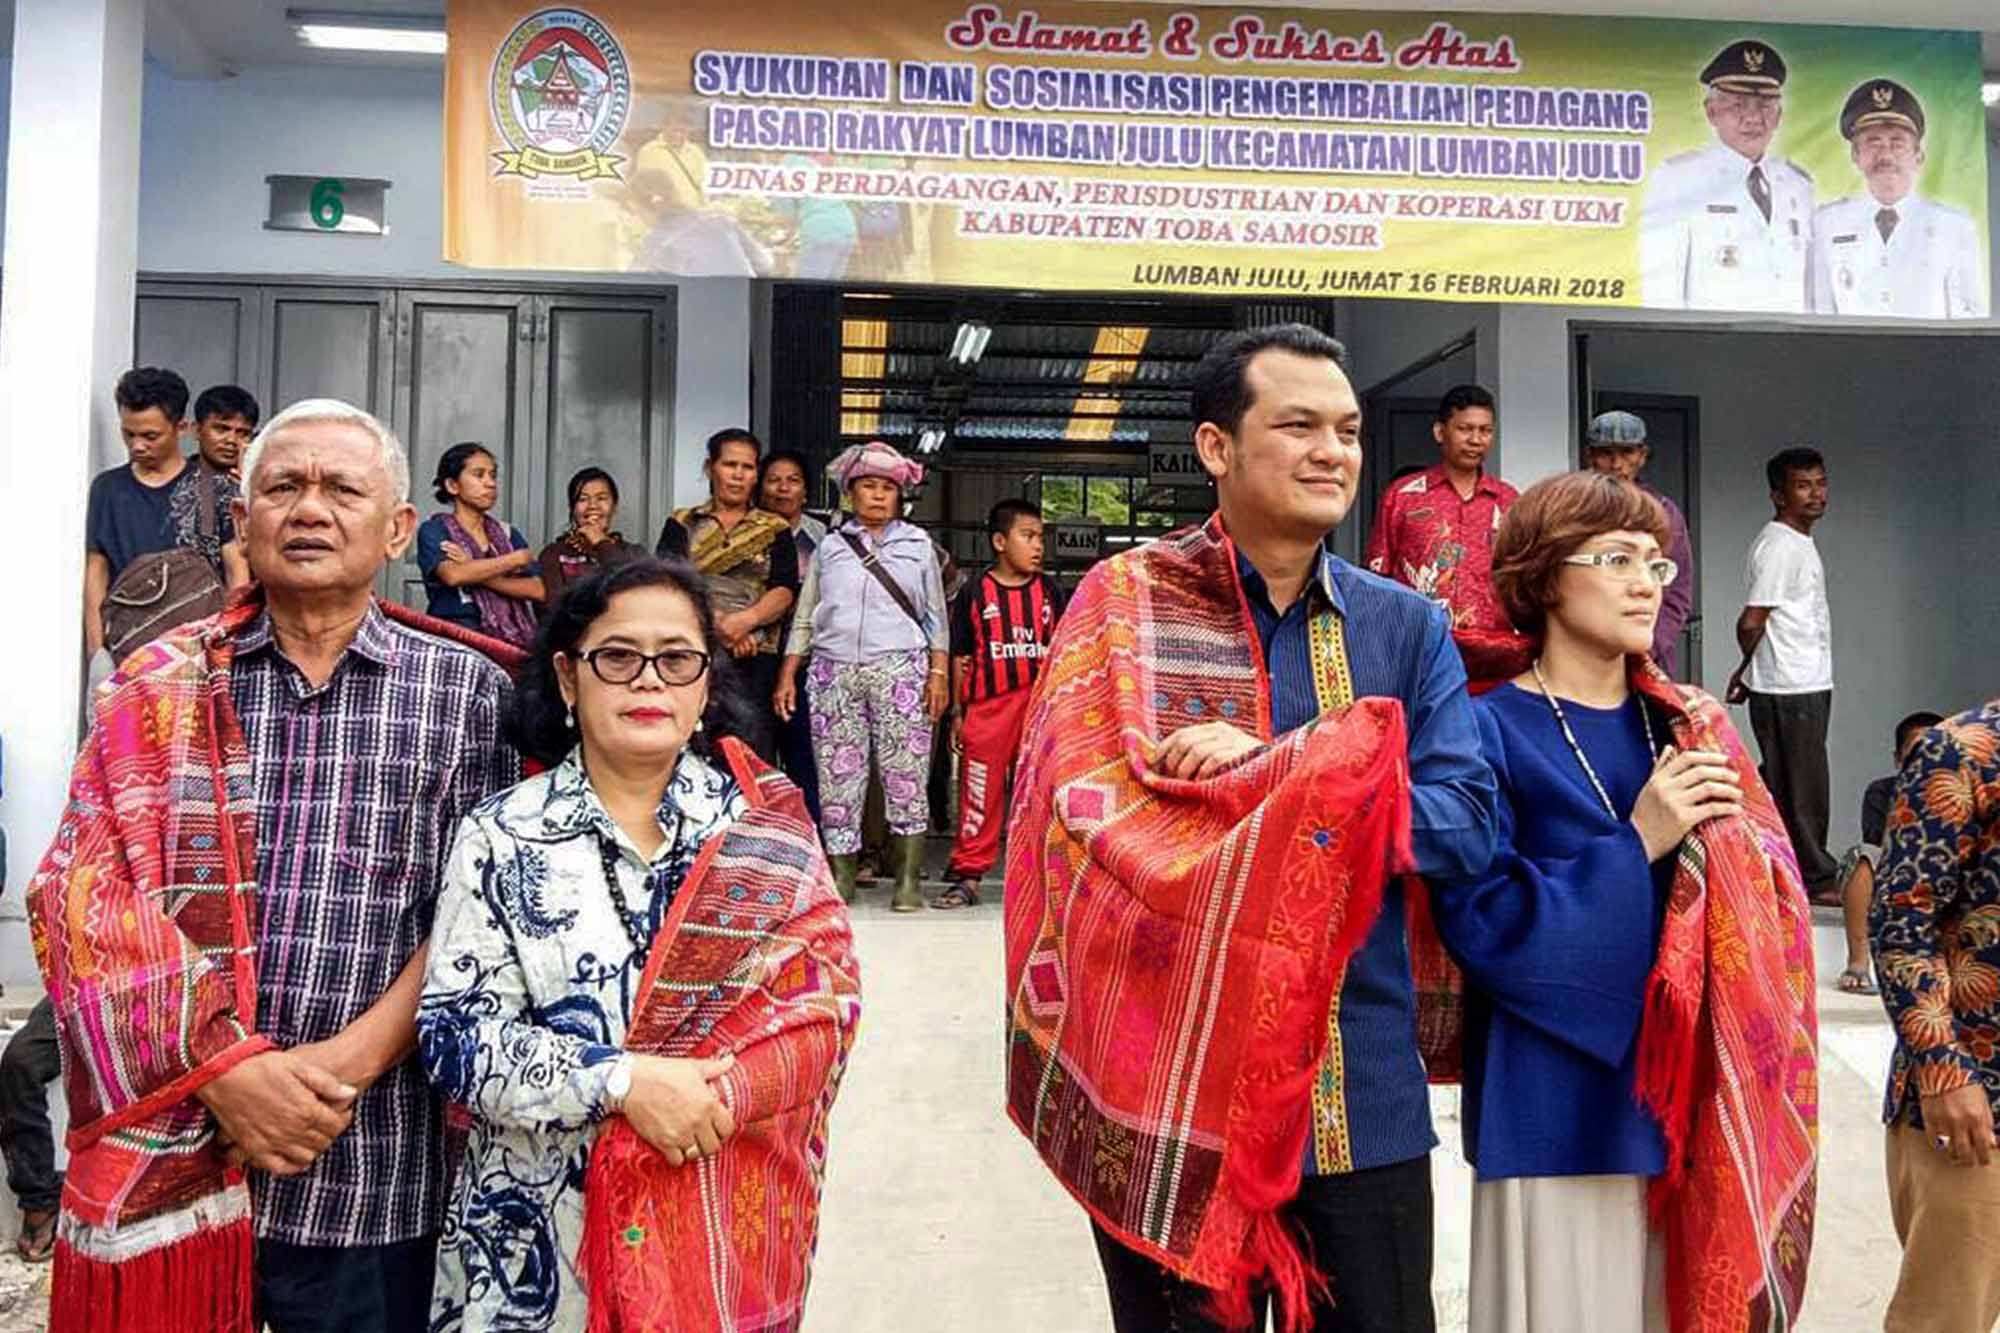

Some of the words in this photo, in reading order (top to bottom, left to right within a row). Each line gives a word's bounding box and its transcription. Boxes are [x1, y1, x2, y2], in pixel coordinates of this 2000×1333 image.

[950, 8, 1147, 53] Selamat
[1165, 15, 1195, 55] &
[1213, 19, 1384, 63] Sukses
[1399, 26, 1517, 68] Atas
[699, 54, 888, 98] SYUKURAN
[903, 64, 973, 103] DAN
[990, 68, 1203, 112] SOSIALISASI
[1211, 77, 1465, 123] PENGEMBALIAN
[1473, 87, 1650, 130] PEDAGANG
[713, 107, 828, 148] PASAR
[836, 113, 966, 155] RAKYAT
[974, 119, 1115, 161] LUMBAN
[1123, 126, 1202, 165] JULU
[1211, 128, 1411, 172] KECAMATAN
[1420, 137, 1558, 177] LUMBAN
[1565, 143, 1643, 180] JULU
[310, 177, 345, 229] 6
[708, 166, 807, 193] DINAS
[814, 171, 1065, 207] PERDAGANGAN,
[1072, 182, 1317, 213] PERISDUSTRIAN
[1322, 191, 1388, 215] DAN
[1396, 195, 1546, 219] KOPERASI
[1551, 201, 1624, 223] UKM
[961, 211, 1147, 239] KABUPATEN
[1156, 218, 1233, 241] TOBA
[1243, 220, 1380, 246] SAMOSIR
[1133, 264, 1240, 286] LUMBAN
[1246, 268, 1311, 292] JULU,
[1317, 270, 1404, 291] JUMAT
[1408, 274, 1437, 293] 16
[1443, 275, 1560, 297] FEBRUARI
[1567, 279, 1625, 299] 2018
[1057, 531, 1097, 548] KAIN
